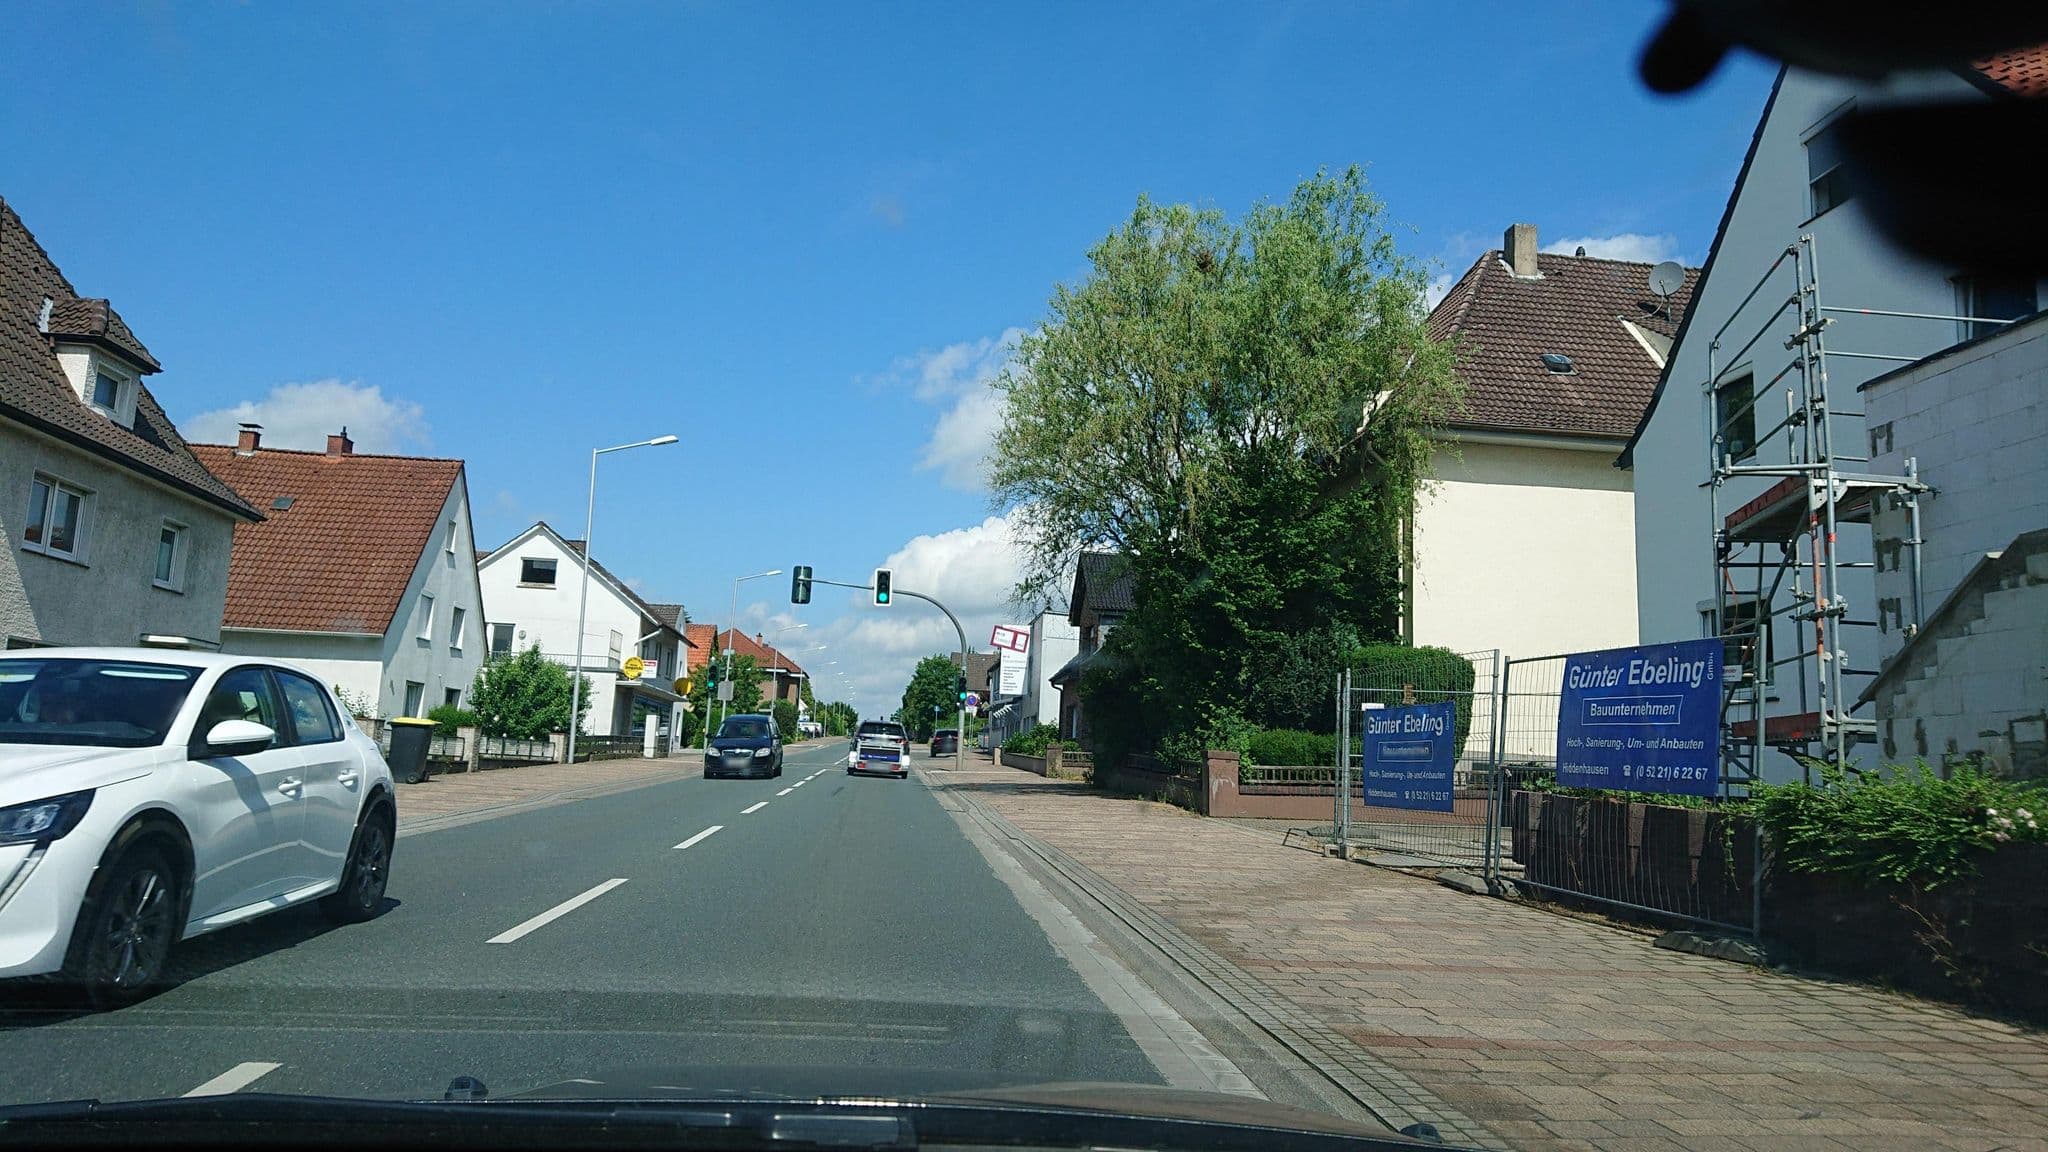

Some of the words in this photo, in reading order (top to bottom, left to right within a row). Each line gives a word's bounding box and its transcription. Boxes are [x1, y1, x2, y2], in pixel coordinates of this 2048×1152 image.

[1569, 663, 1623, 690] Günter
[1628, 657, 1705, 689] Ebeling
[1590, 702, 1675, 717] Bauunternehmen
[1367, 717, 1401, 734] Günter
[1404, 714, 1443, 736] Ebeling
[1627, 738, 1644, 748] Um-
[1646, 738, 1659, 748] und
[1660, 738, 1704, 750] Anbauten
[1562, 762, 1609, 775] Hiddenhausen
[1636, 766, 1644, 780] (0
[1646, 766, 1656, 778] 52
[1657, 766, 1672, 781] 21)
[1673, 767, 1679, 779] 6
[1681, 767, 1692, 779] 22
[1696, 767, 1708, 780] 67
